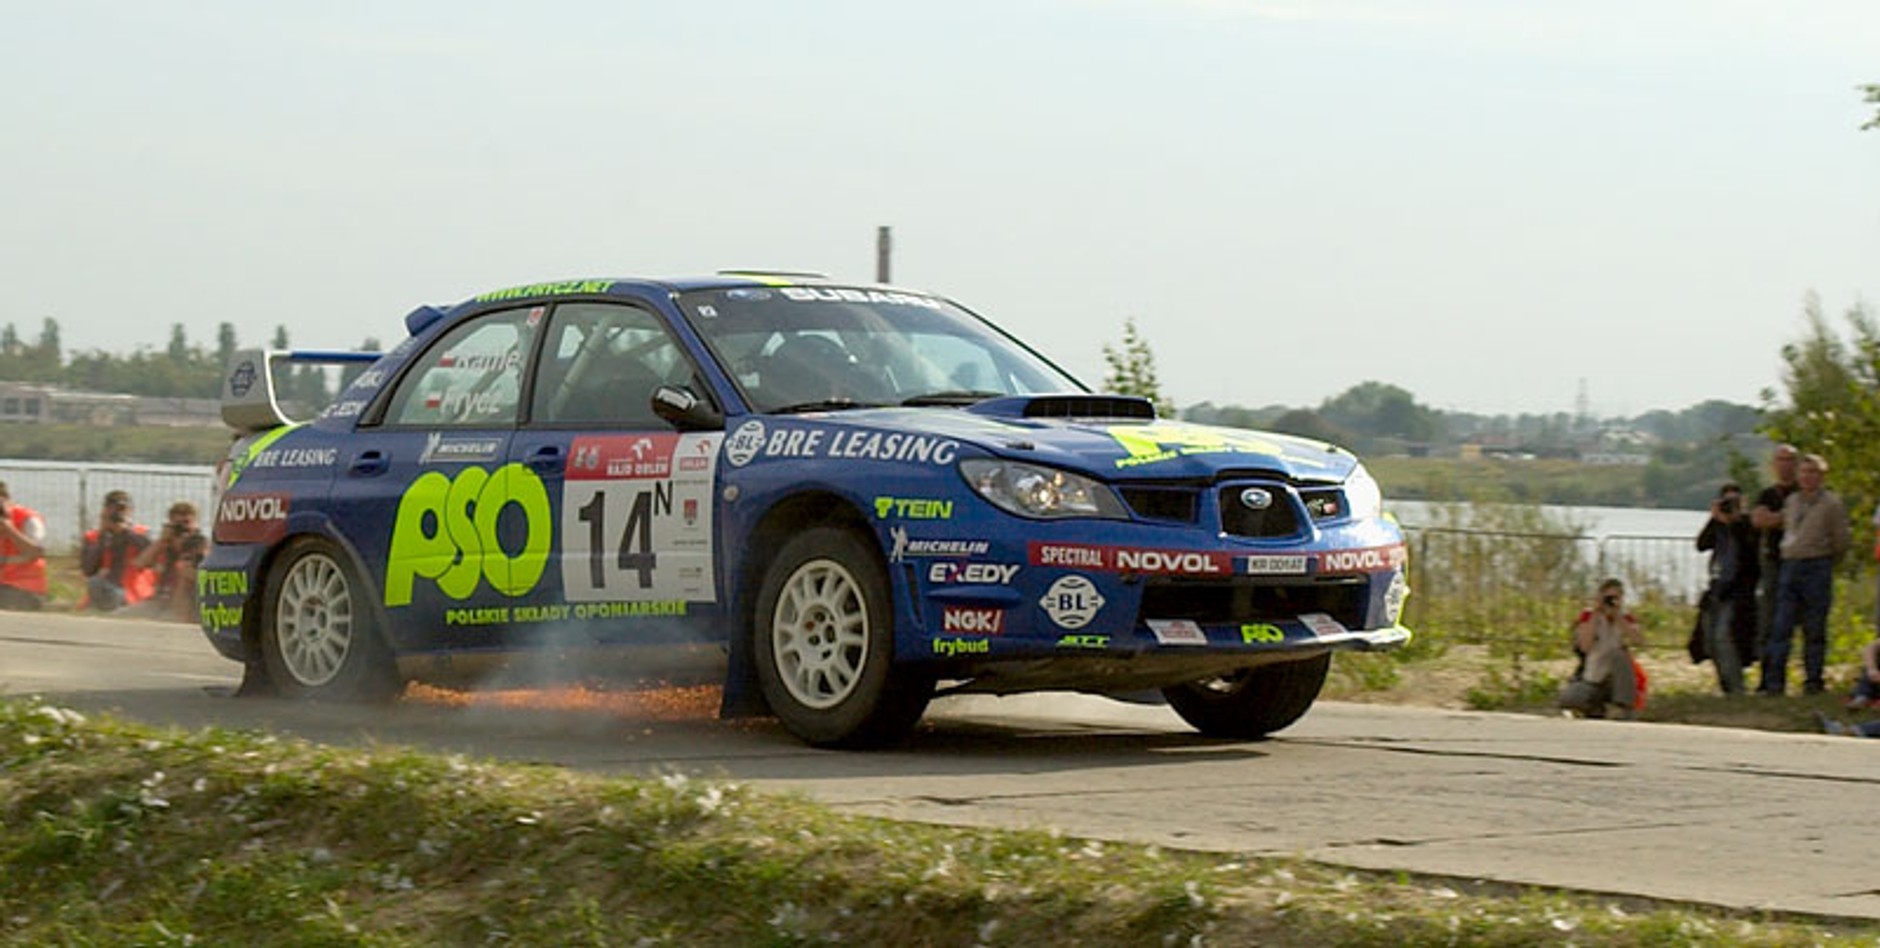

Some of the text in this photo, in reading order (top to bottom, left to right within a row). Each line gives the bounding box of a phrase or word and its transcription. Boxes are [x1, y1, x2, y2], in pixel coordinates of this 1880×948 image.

[780, 287, 942, 310] SUBARU
[280, 449, 337, 467] LEASING
[766, 430, 960, 465] BRE LEASING
[220, 499, 287, 521] NOVOL
[896, 501, 953, 519] TEIN
[385, 463, 553, 606] PSO
[579, 480, 673, 590] 14 N
[908, 541, 989, 554] MICHELIN
[1040, 546, 1220, 572] SPECTRAL NOVOL
[1325, 551, 1385, 571] NOVOL
[208, 571, 248, 594] TEIN
[929, 563, 1020, 584] EXEDY
[1058, 593, 1089, 611] BL
[446, 608, 510, 625] POLSKIE
[932, 638, 990, 657] frybud
